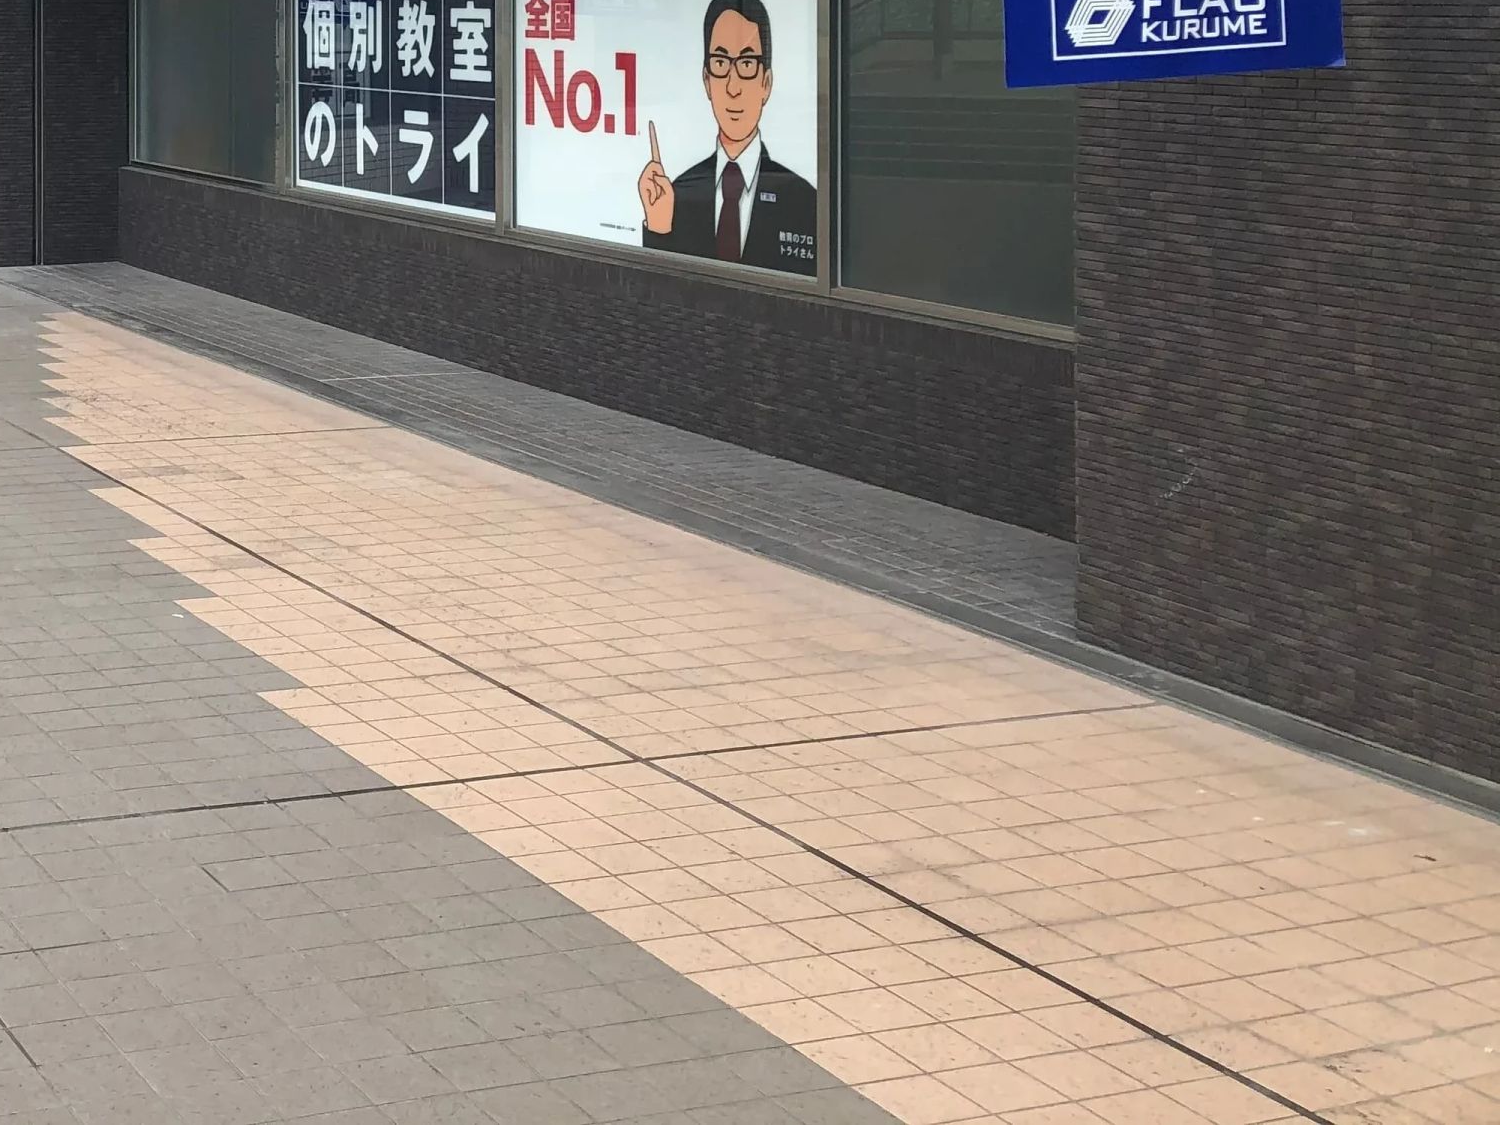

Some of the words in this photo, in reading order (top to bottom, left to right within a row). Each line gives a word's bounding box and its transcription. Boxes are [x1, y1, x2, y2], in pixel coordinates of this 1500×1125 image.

[303, 0, 493, 83] 個別教室
[1140, 13, 1267, 43] KURUME
[525, 48, 637, 136] No.1
[304, 101, 490, 193] のトライ
